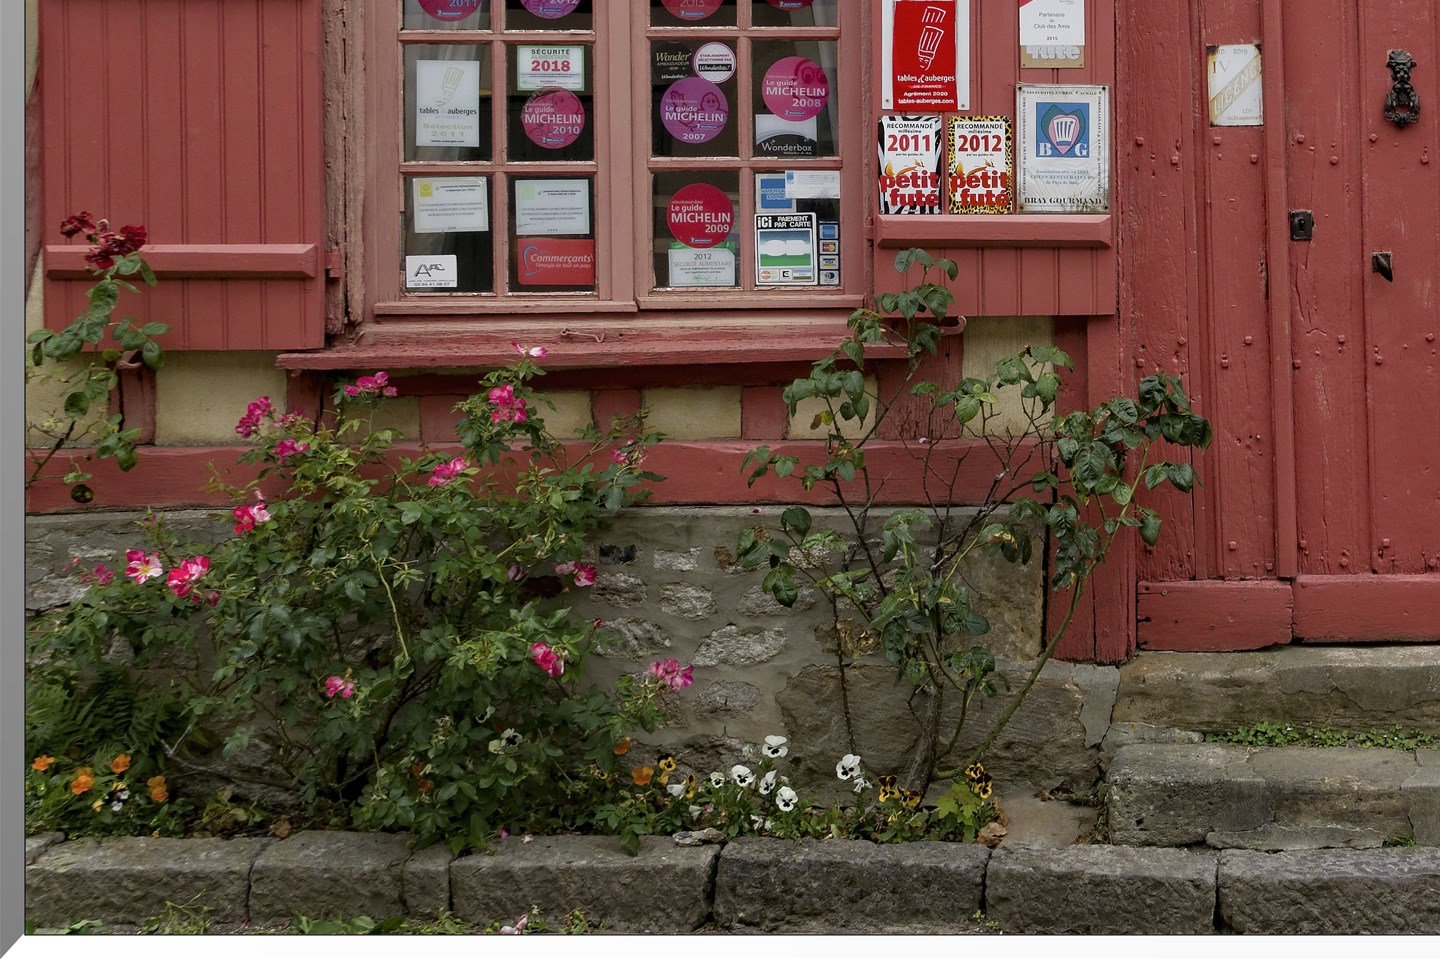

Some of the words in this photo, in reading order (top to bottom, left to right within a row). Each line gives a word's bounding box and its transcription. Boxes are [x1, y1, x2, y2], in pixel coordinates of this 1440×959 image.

[656, 52, 690, 62] Wonder
[531, 60, 571, 72] 2018
[1212, 60, 1230, 74] IV
[776, 79, 798, 87] guide
[897, 74, 917, 82] tables
[925, 74, 955, 84] auberges
[766, 87, 826, 96] MICHELIN
[1213, 60, 1258, 115] LICENC
[792, 98, 821, 107] 2008
[419, 107, 439, 115] tables
[447, 107, 477, 117] auberges
[535, 106, 555, 114] guide
[676, 105, 698, 113] guide
[525, 114, 581, 124] MICHELIN
[665, 112, 724, 122] MICHELIN
[553, 125, 580, 134] 2010
[886, 122, 933, 130] RECOMMANDÉ
[956, 122, 1003, 130] RECOMMANDÉ
[761, 141, 812, 152] Wonderbox
[887, 134, 931, 152] 2011
[958, 134, 1002, 152] 2012
[1039, 142, 1052, 156] B
[1074, 142, 1088, 157] G
[880, 170, 939, 193] petit
[950, 170, 1010, 193] petit
[889, 188, 939, 207] futé
[960, 188, 1010, 207] futé
[1049, 197, 1102, 205] GOURMAND
[681, 204, 704, 213] guide
[671, 213, 730, 223] MICHELIN
[705, 224, 730, 233] 2009
[530, 252, 591, 264] Commerçants
